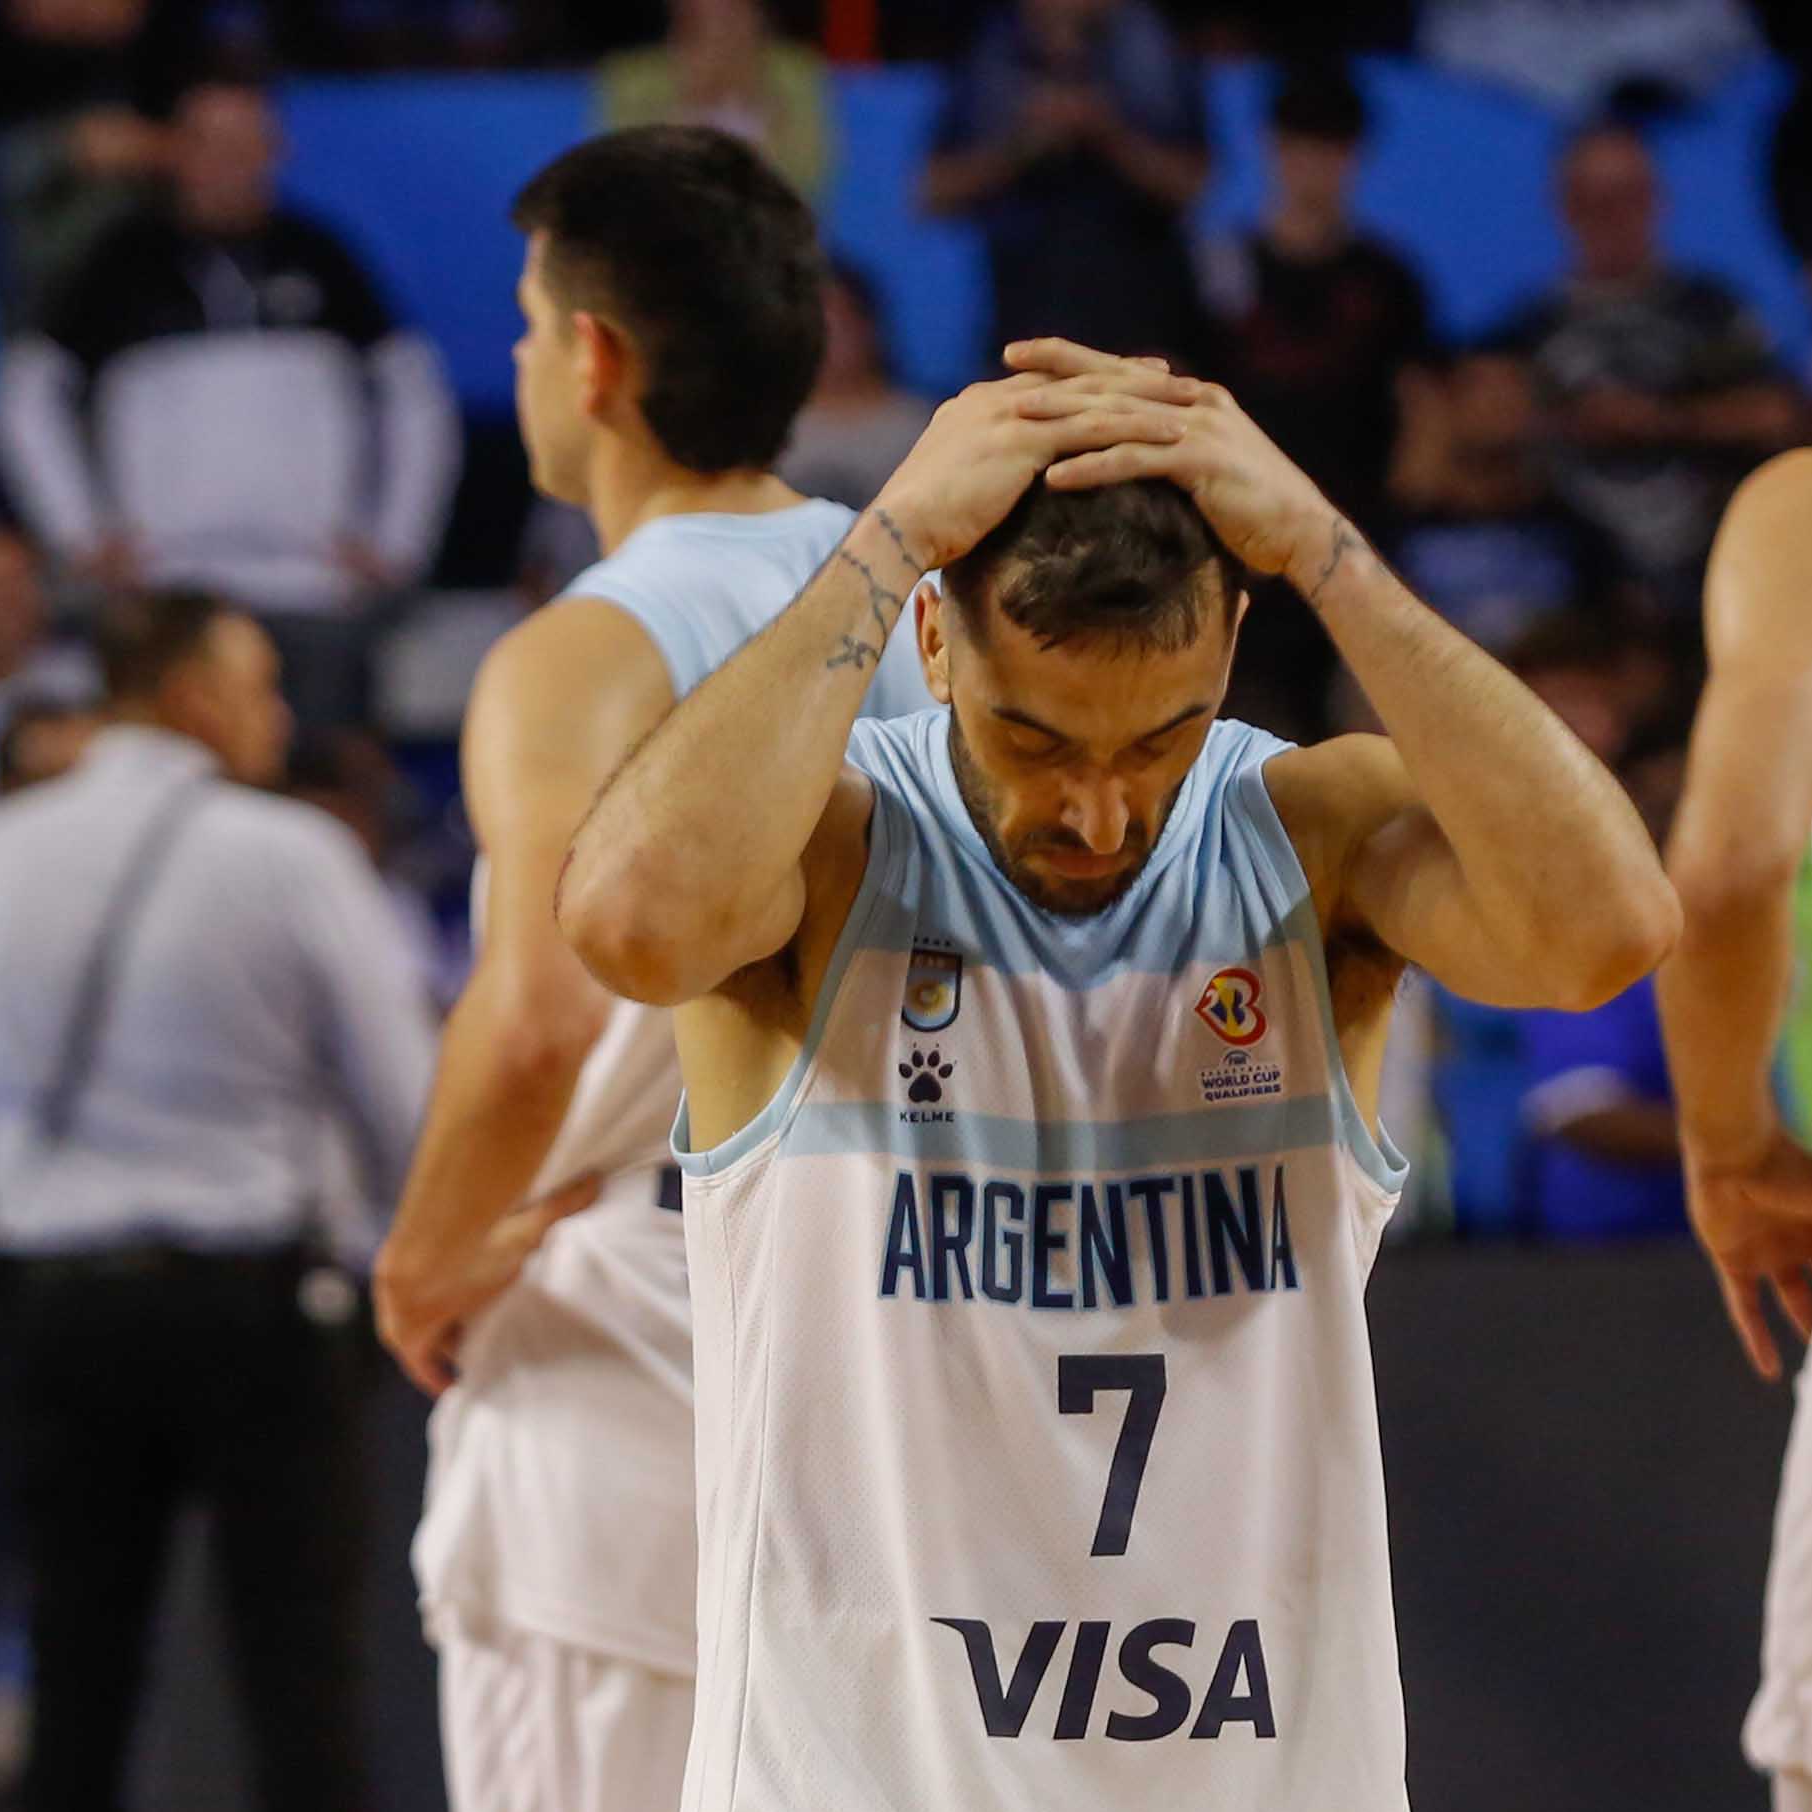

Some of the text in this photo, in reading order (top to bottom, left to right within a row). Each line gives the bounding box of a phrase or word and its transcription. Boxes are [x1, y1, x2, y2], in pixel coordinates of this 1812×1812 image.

[899, 1111, 955, 1123] KELME
[1202, 1071, 1281, 1089] WORLD CUP
[880, 1165, 1300, 1312] ARGENTINA
[1057, 1354, 1167, 1557] 7
[929, 1617, 1277, 1741] VISA
